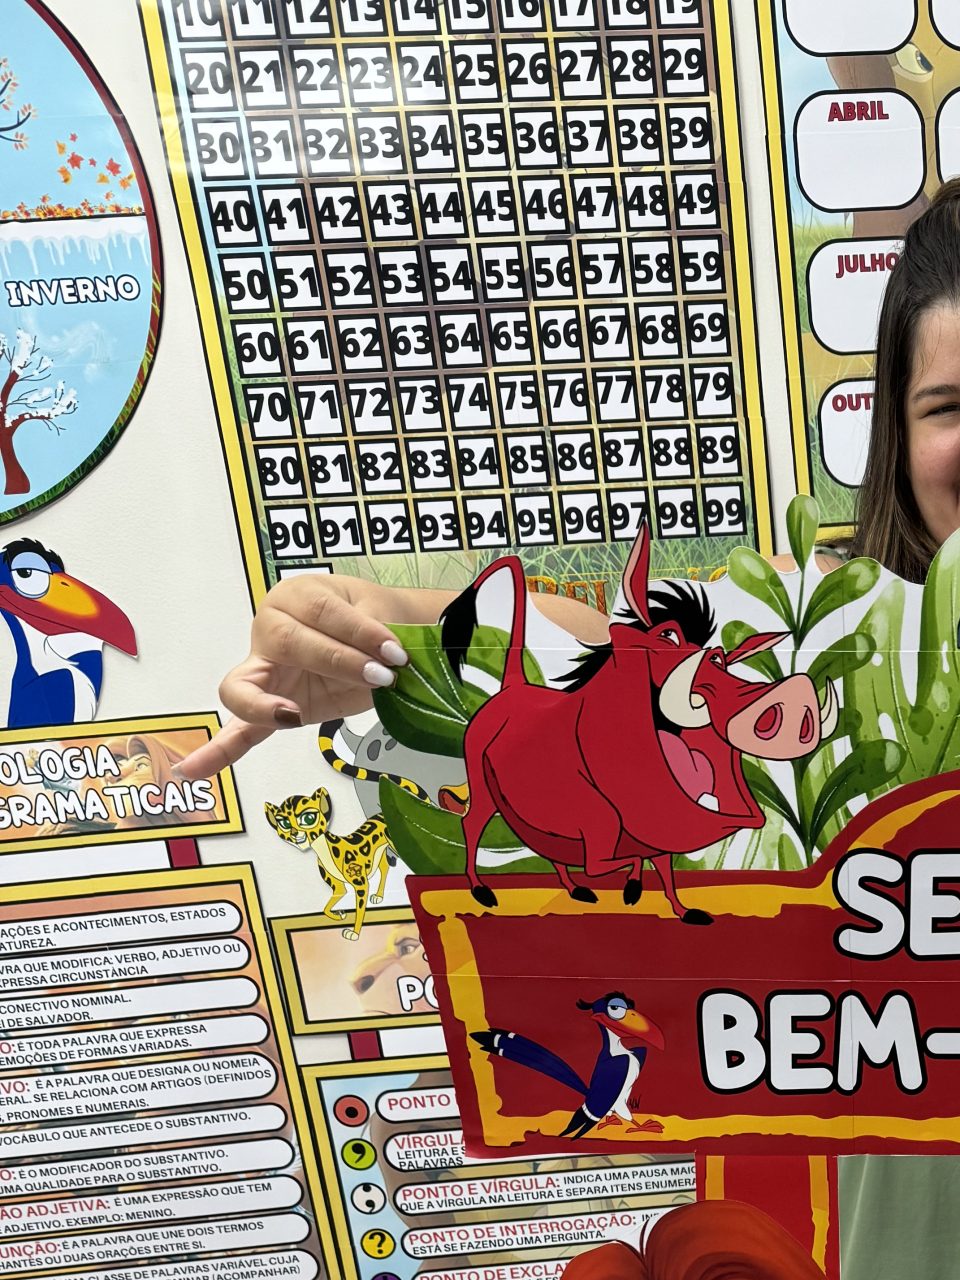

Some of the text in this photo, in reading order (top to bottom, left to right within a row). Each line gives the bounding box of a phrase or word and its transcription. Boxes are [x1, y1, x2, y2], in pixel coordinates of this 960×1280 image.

[828, 101, 889, 122] ABRIL
[227, 251, 724, 300] 50 51 52 53 54 55 56 57 58 59
[6, 273, 140, 307] INVERNO
[272, 498, 745, 550] 90 91 92 93 94 95 96 97 98 99
[43, 925, 50, 934] E
[54, 913, 168, 932] ACONTECIMENTOS,
[170, 908, 226, 921] ESTADOS
[72, 994, 131, 1008] NOMINAL.
[18, 1024, 207, 1052] É TODA PALAVRA QUE EXPRESSA
[59, 1050, 76, 1060] DE
[78, 1046, 129, 1058] FORMAS
[130, 1038, 192, 1053] VARIADAS.
[388, 1094, 450, 1110] PONTO
[63, 1112, 250, 1139] QUE ANTECEDE O SUBSTANTIVO.
[402, 1168, 668, 1200] PONTO E VÍRGULA: INDICA UMA PAUSA
[27, 1199, 110, 1217] ADJETIVA:
[400, 1183, 642, 1212] QUE A VÍRGULA NA LEITURA E SEPARA ITENS
[409, 1230, 470, 1245] PONTO
[473, 1227, 497, 1238] DE
[500, 1214, 636, 1236] INTERROGAÇÃO:
[413, 1229, 605, 1254] ESTÁ SE FAZENDO UMA PERGUNTA.
[484, 1269, 506, 1280] DE
